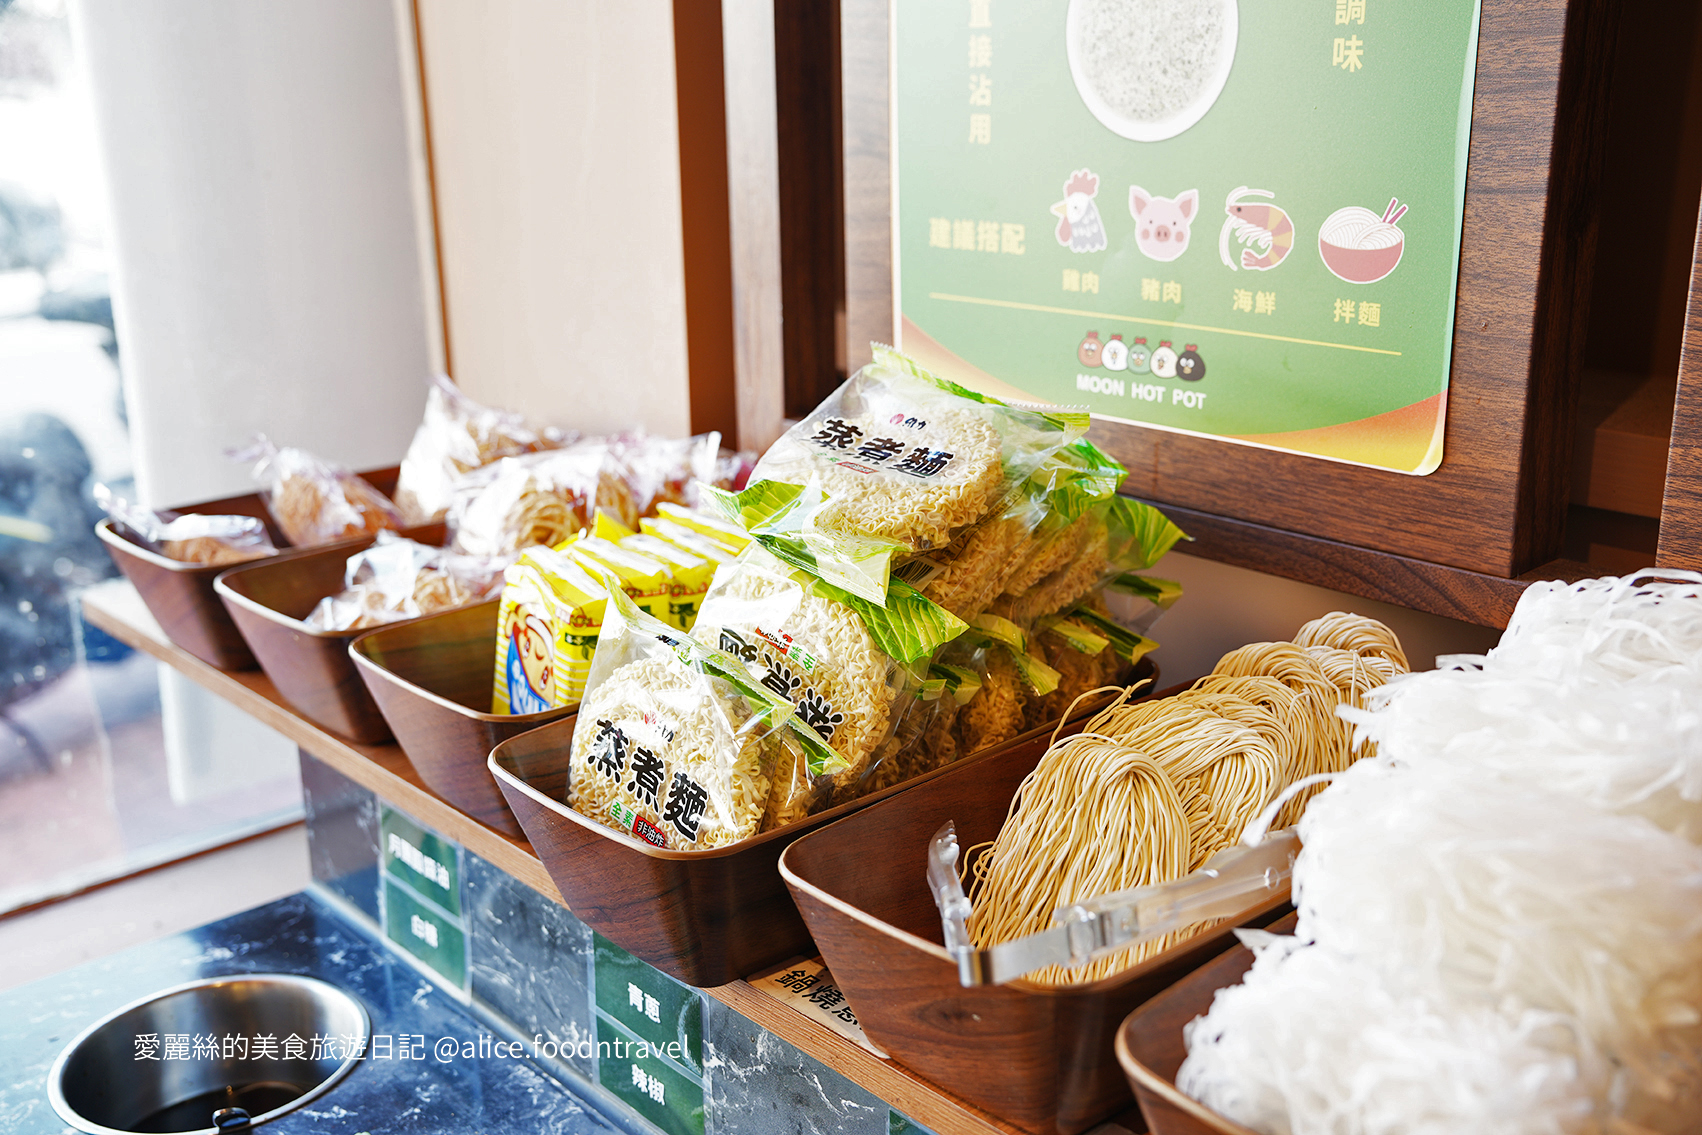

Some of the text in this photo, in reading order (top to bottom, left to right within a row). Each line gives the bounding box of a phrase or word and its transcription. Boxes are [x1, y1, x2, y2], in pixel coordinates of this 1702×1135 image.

[929, 217, 1026, 256] 建議搭配
[1141, 278, 1182, 304] 豬肉
[1232, 288, 1277, 316] 海鮮
[1333, 298, 1381, 327] 拌麵
[1076, 373, 1207, 410] MOON HOT POT
[811, 419, 954, 479] 蒸煮麵
[587, 719, 708, 842] 蒸煮麵
[611, 801, 665, 848] 全素 非油炸
[631, 1064, 666, 1106] 辣椒
